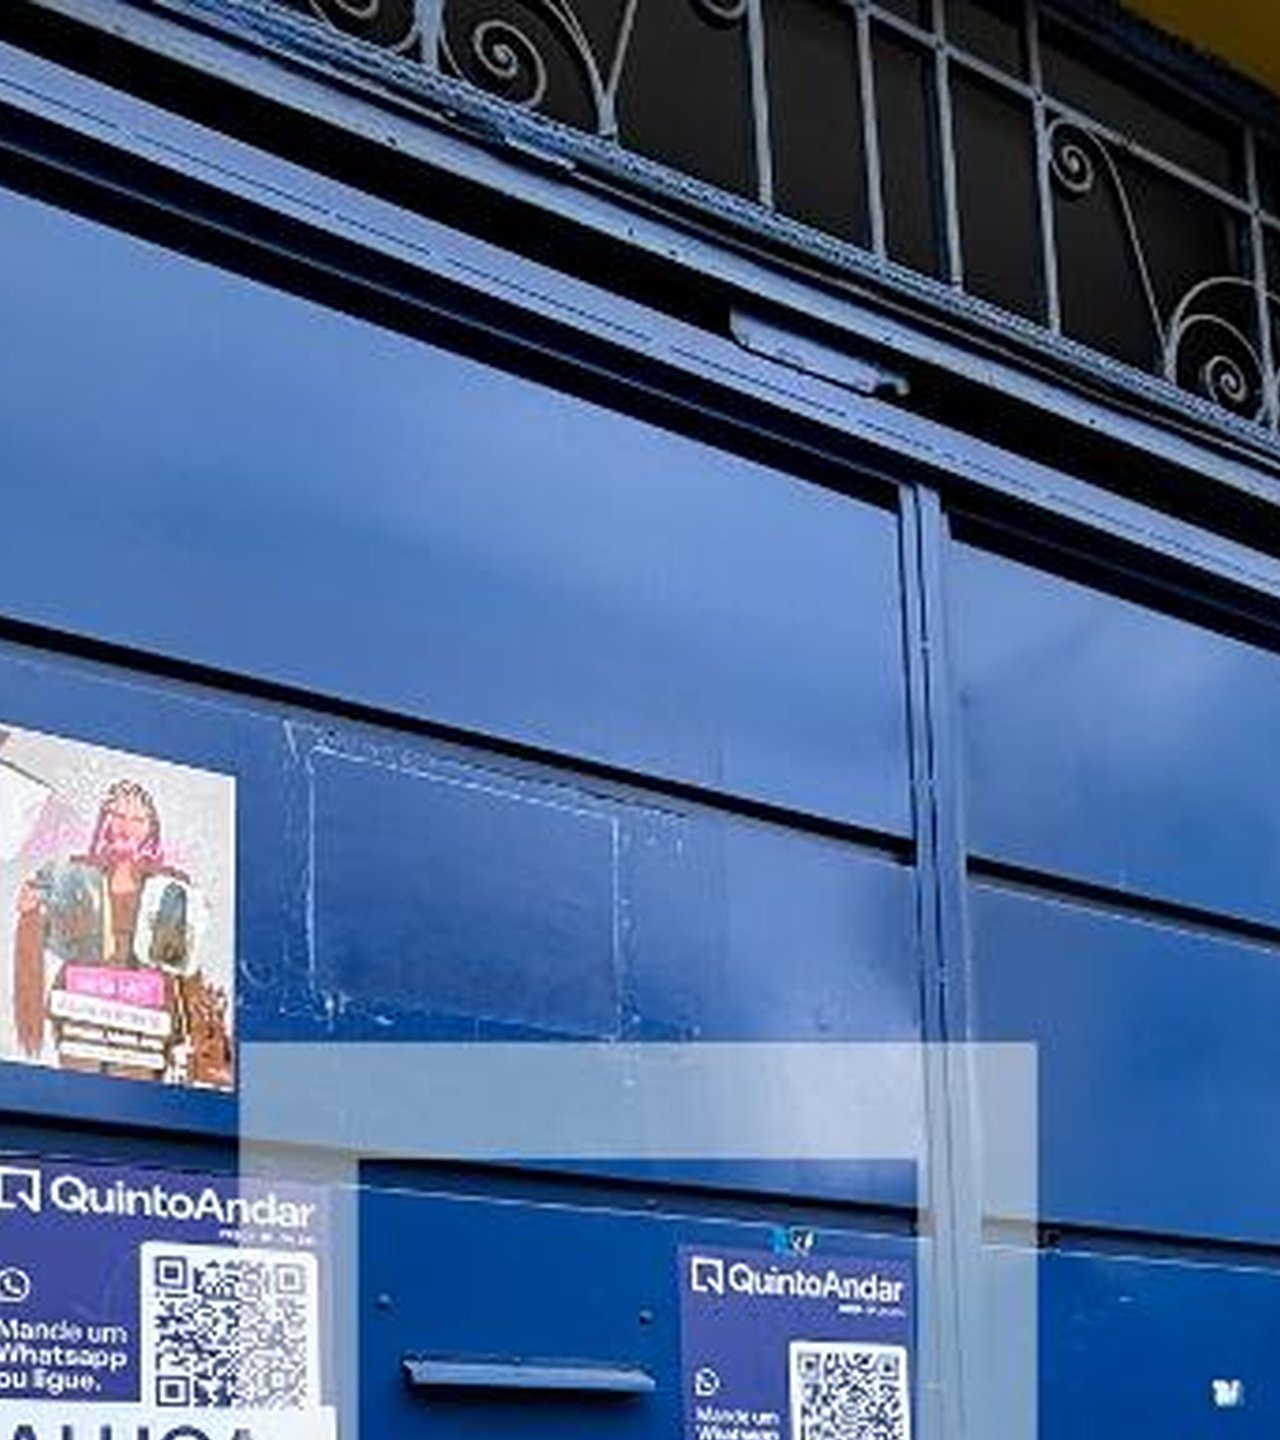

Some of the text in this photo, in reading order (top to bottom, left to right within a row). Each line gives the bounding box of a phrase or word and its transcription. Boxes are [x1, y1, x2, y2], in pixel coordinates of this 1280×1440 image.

[50, 1176, 316, 1228] QuintoAndar
[728, 1263, 903, 1303] QuintoAndar
[88, 1325, 128, 1345] um
